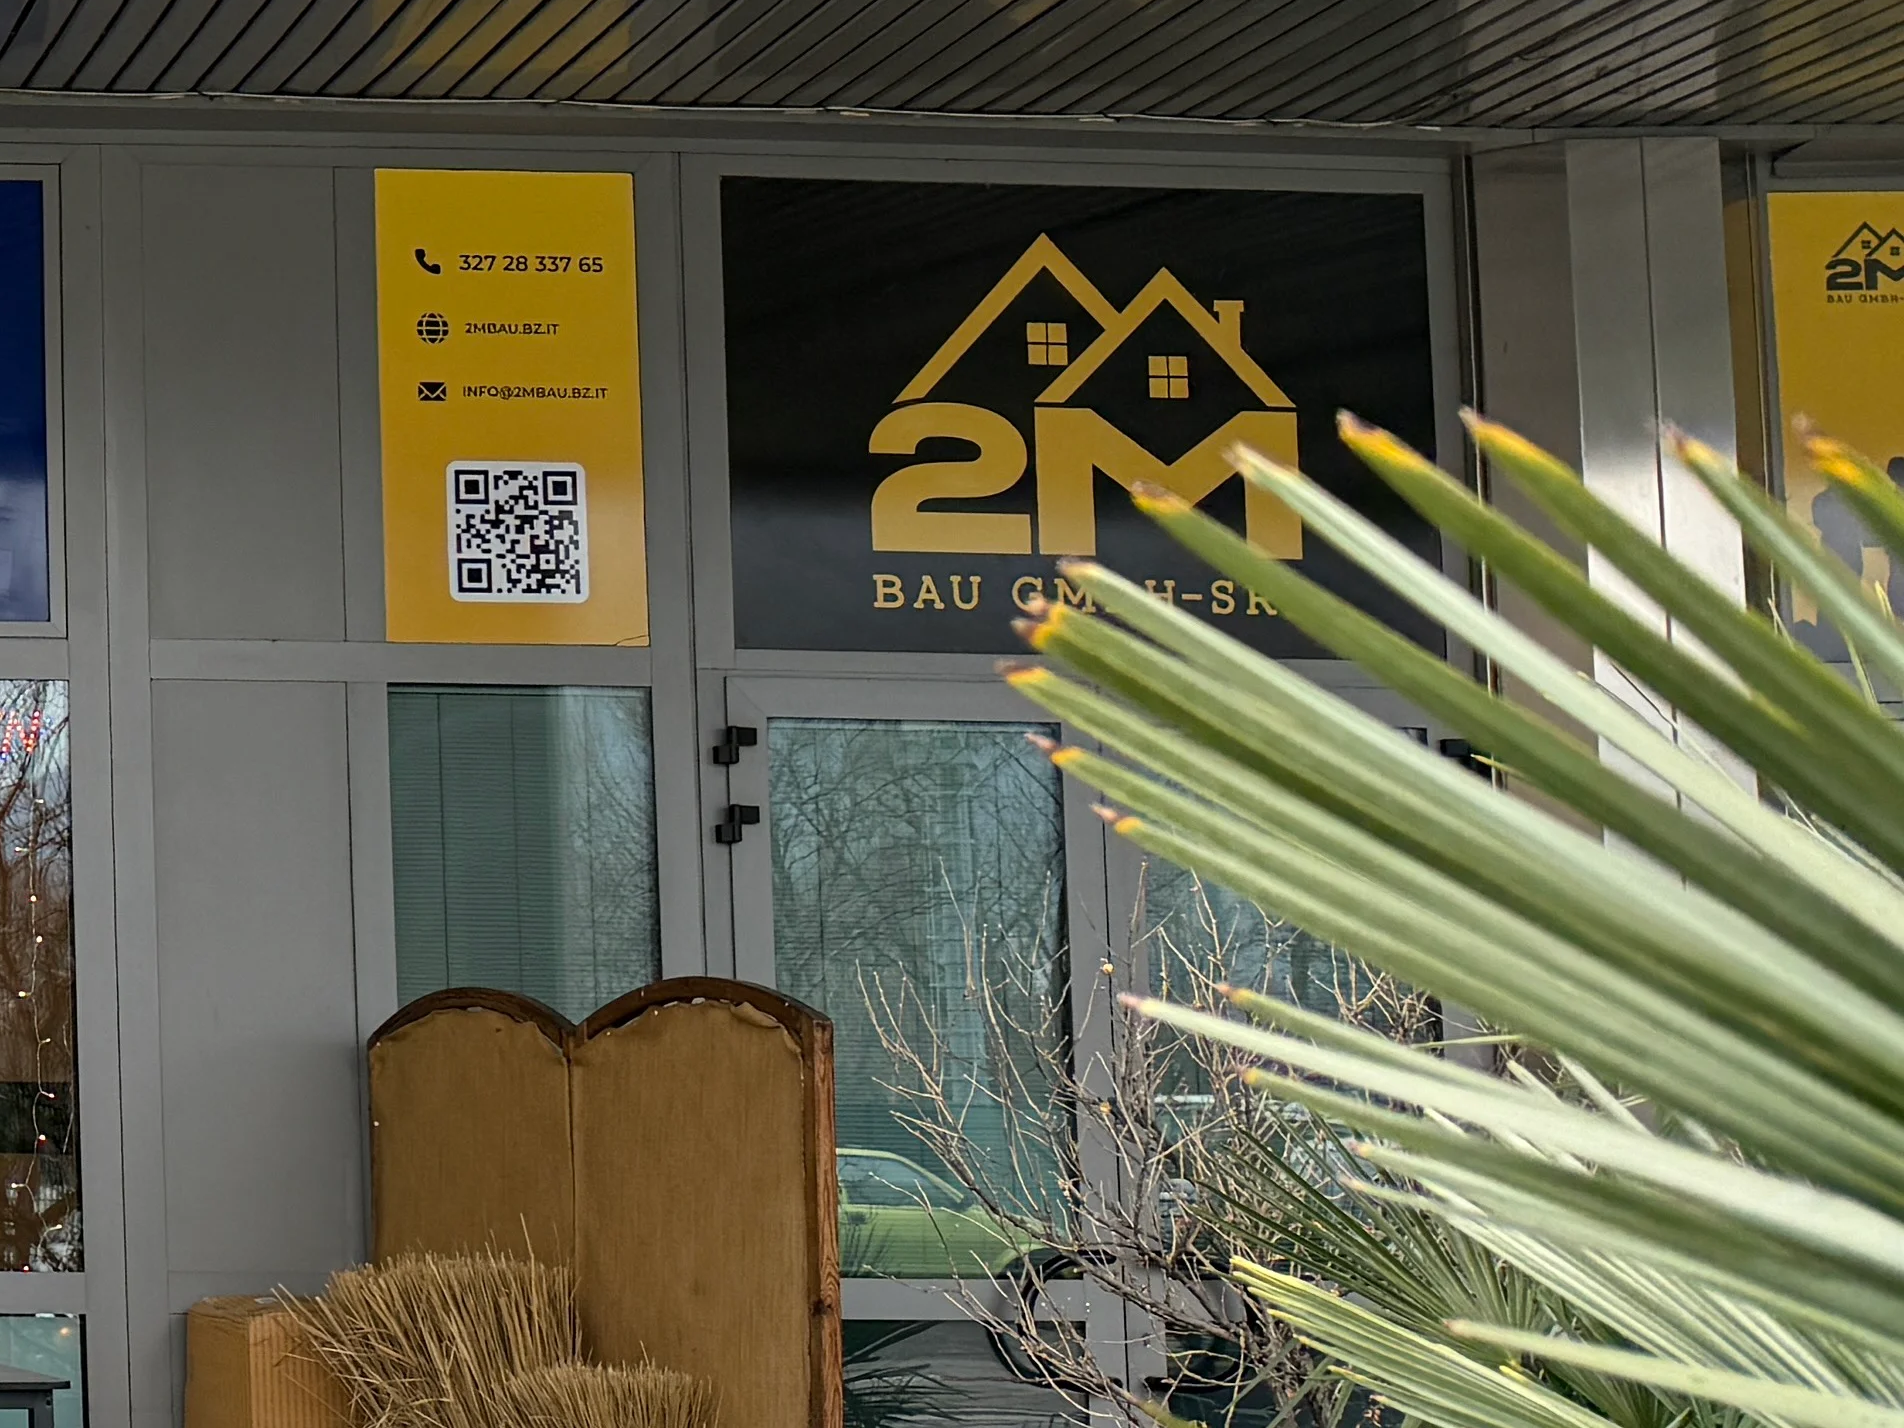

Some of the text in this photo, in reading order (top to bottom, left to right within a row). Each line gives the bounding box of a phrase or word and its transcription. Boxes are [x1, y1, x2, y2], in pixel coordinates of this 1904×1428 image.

[459, 254, 603, 273] 327 28 337 65
[465, 323, 559, 335] 2MBAU.BZ.IT
[462, 386, 608, 400] INFO@2MBAU.BZ.IT
[869, 402, 1303, 560] 2M
[874, 574, 1278, 616] BAU GMH-SR
